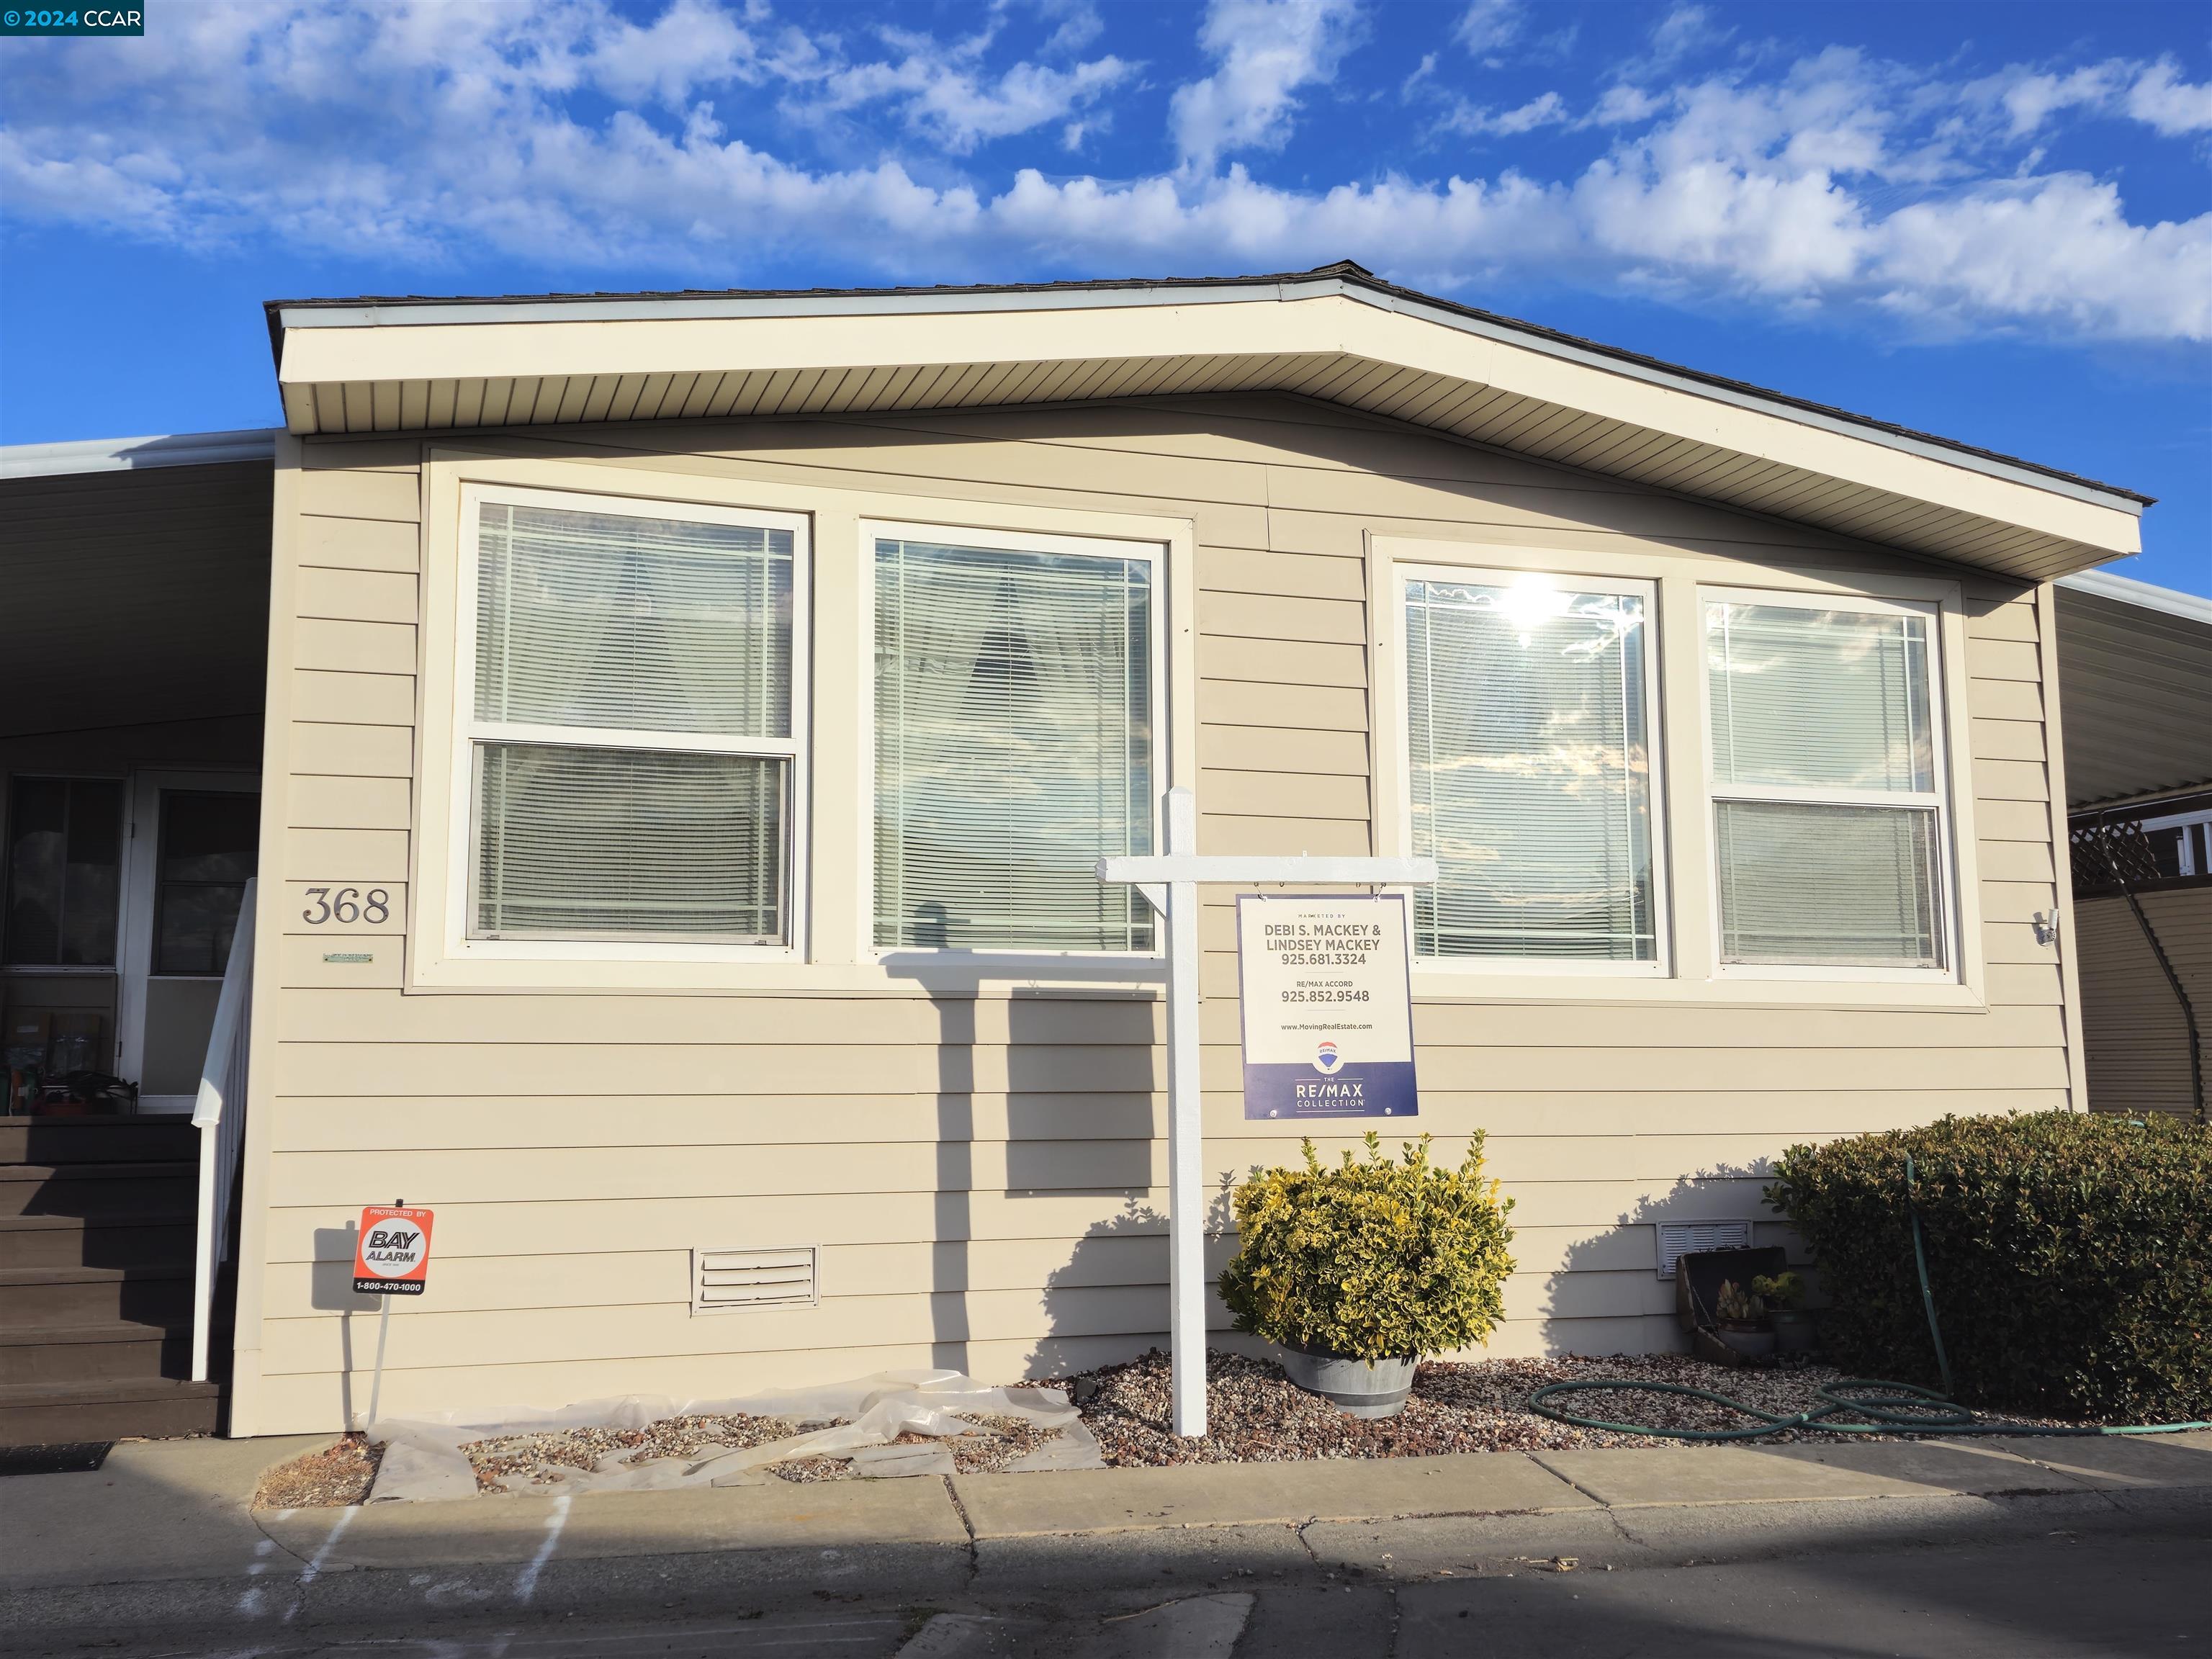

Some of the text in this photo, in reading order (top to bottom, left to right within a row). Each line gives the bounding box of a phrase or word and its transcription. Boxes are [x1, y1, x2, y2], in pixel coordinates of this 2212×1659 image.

[302, 888, 390, 925] 368
[1264, 925, 1381, 936] DEBI S. MACKEY &
[1267, 939, 1380, 950] LINDSEY MACKEY
[1281, 953, 1367, 965] 925.681.3324
[1281, 990, 1370, 1002] 925.852.9548
[1296, 1084, 1363, 1098] RE/MAX
[1297, 1099, 1364, 1107] COLLECTION
[369, 1231, 421, 1249] BAY
[356, 1282, 421, 1291] 1-800-470-1000
